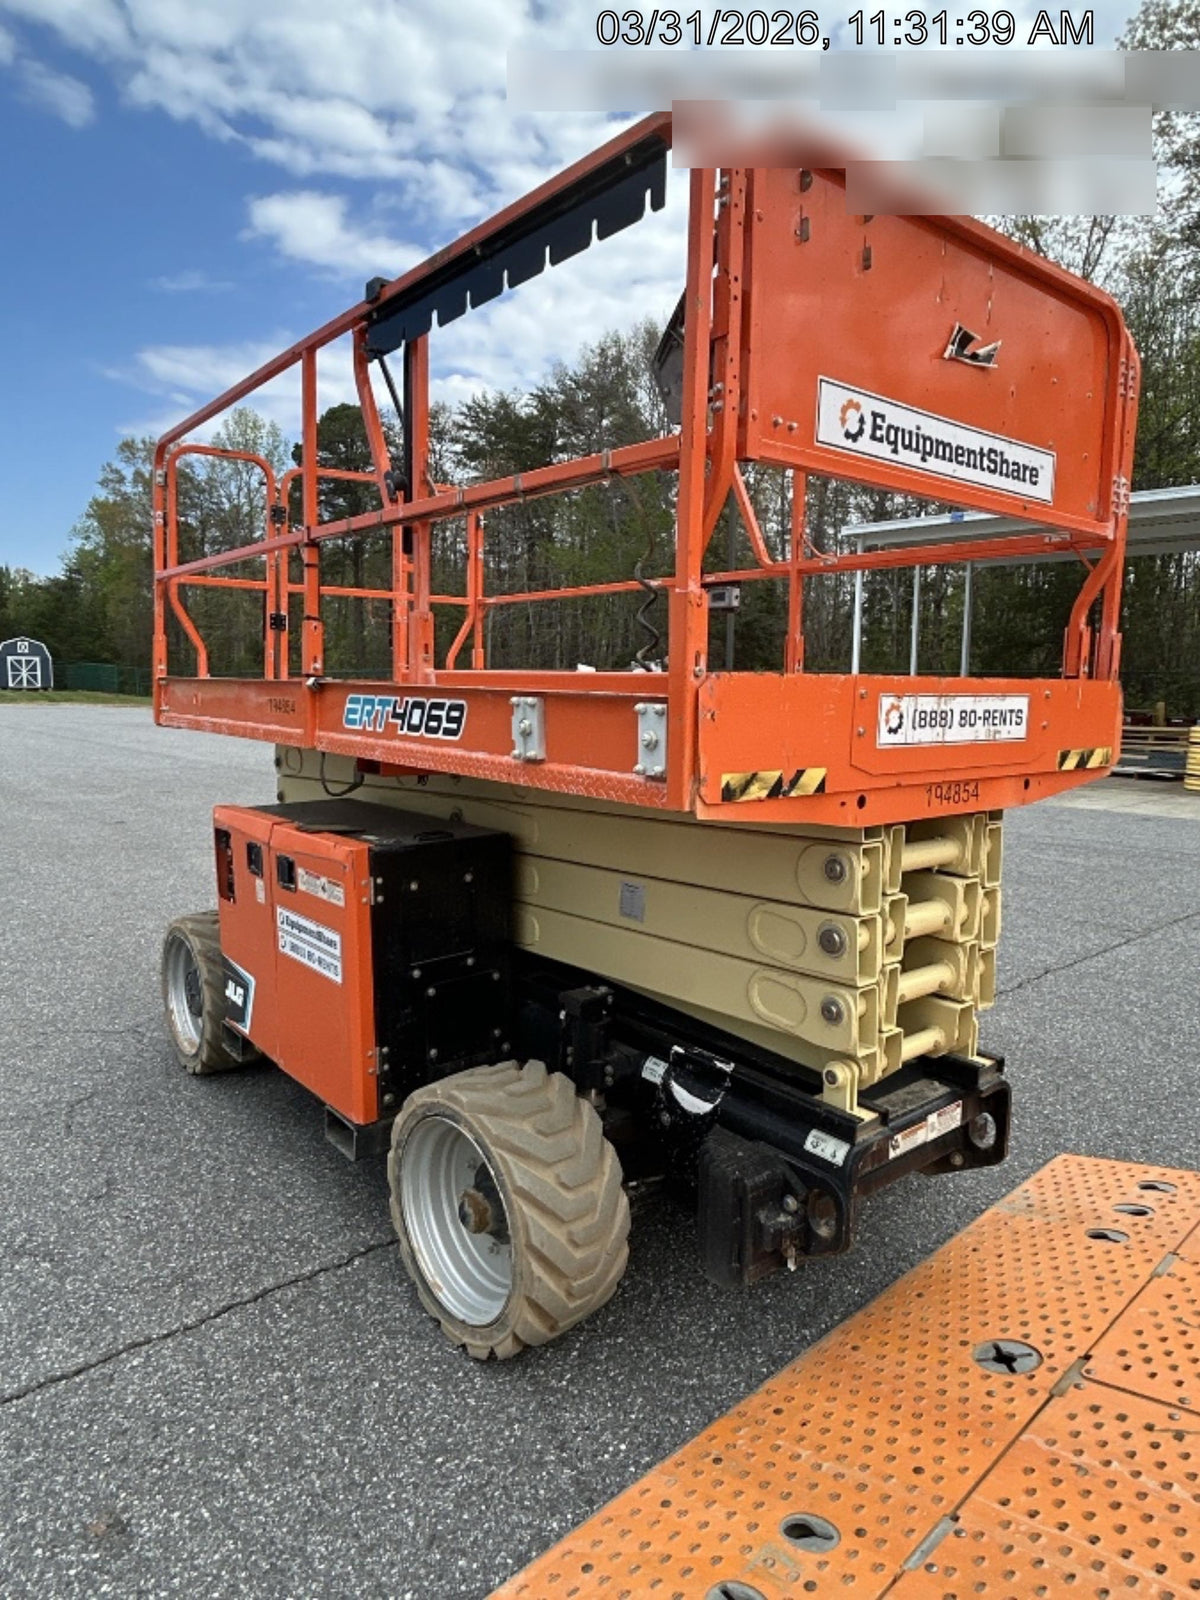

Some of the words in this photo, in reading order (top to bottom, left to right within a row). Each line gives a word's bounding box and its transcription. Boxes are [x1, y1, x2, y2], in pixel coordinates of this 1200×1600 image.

[869, 411, 1040, 486] EquipmentShare
[344, 695, 466, 738] ERT4069
[911, 708, 954, 730] (888)
[958, 708, 1024, 728] 80-RENTS
[926, 782, 980, 807] 194854
